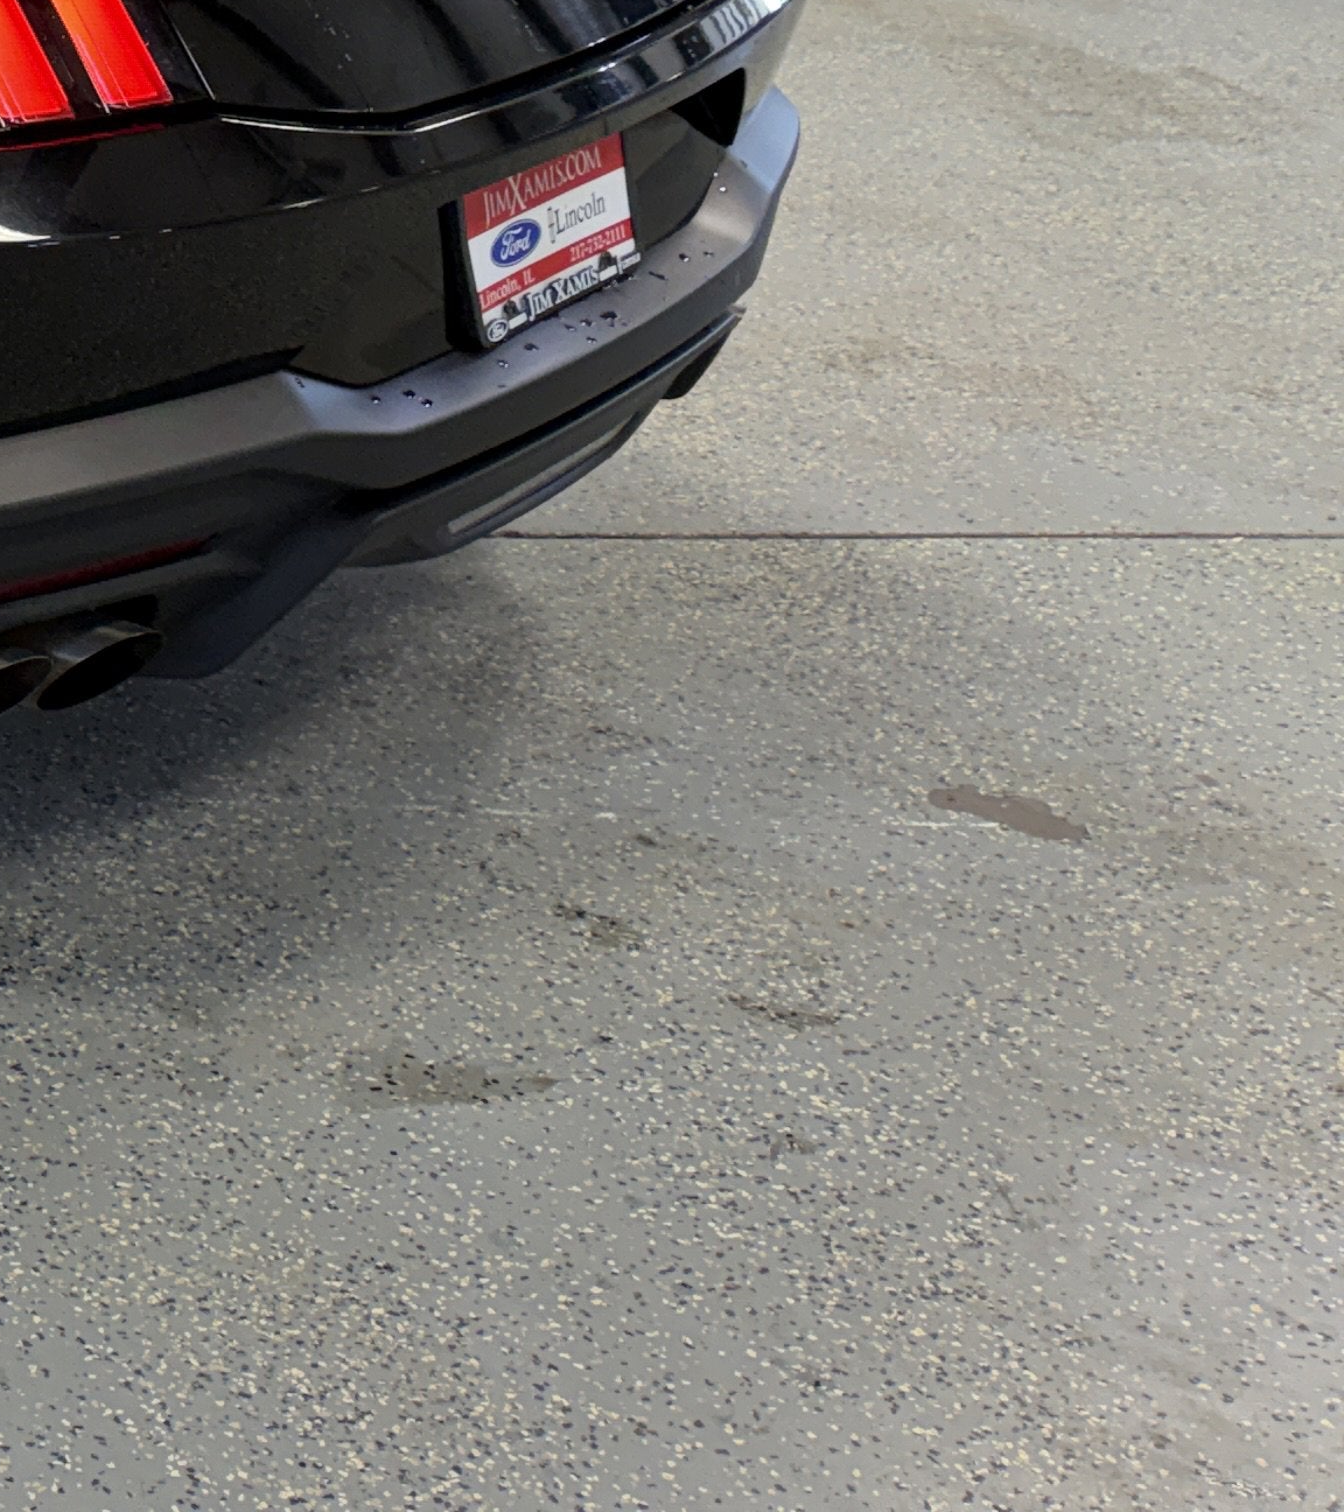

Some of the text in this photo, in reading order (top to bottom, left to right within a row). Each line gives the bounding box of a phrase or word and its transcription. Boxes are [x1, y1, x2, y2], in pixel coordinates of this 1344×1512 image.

[554, 192, 606, 235] Lincoln
[499, 226, 532, 261] Ford
[526, 289, 555, 322] JIM
